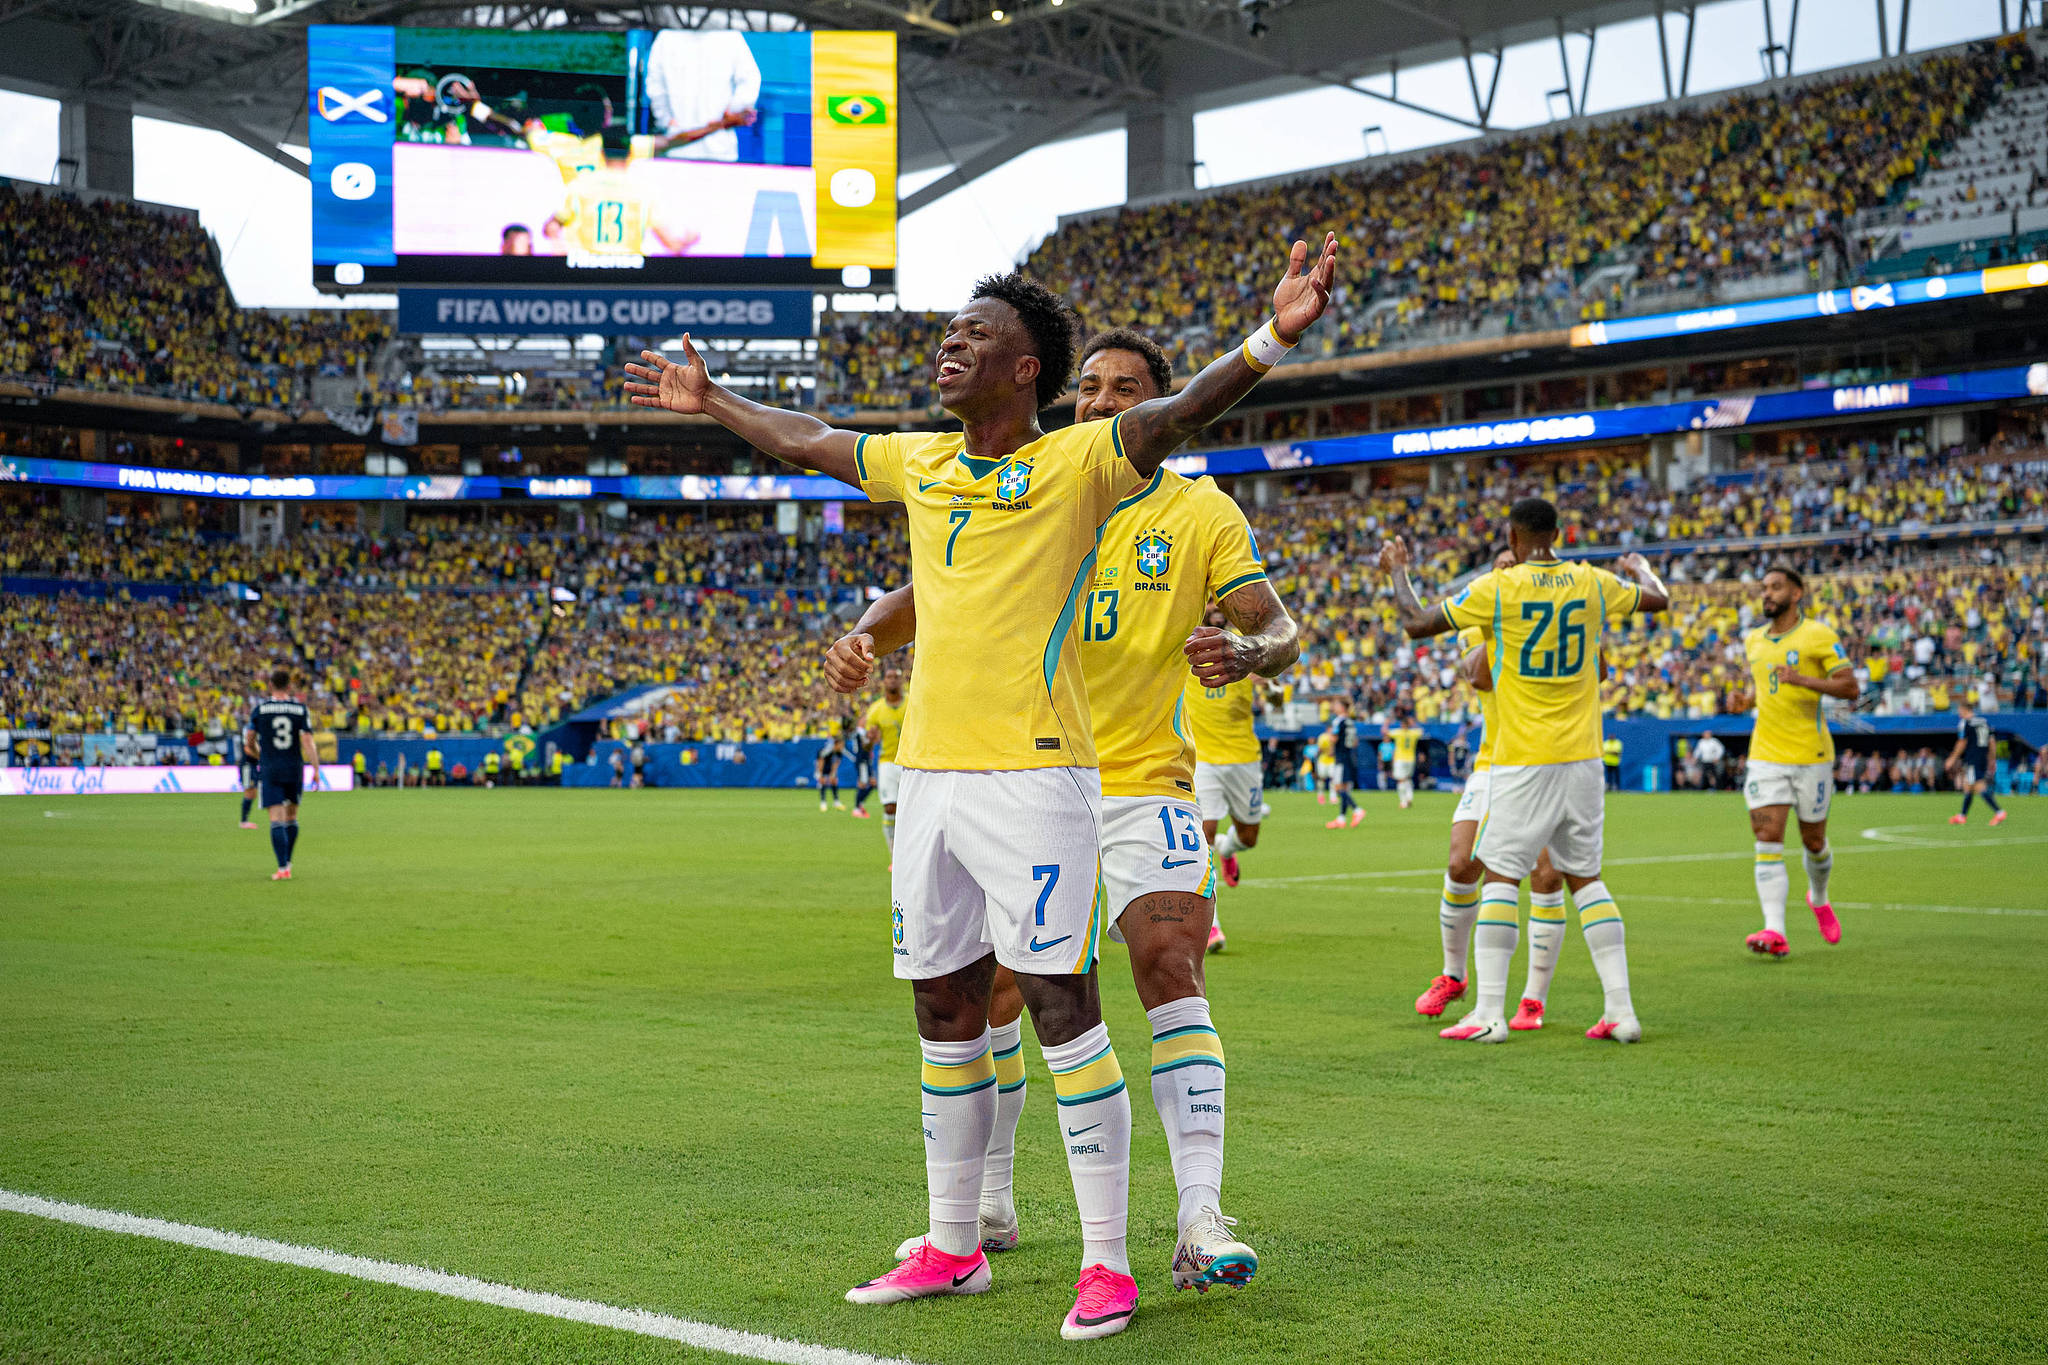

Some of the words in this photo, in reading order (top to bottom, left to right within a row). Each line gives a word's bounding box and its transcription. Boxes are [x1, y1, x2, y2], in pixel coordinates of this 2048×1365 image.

[597, 200, 623, 243] 13
[437, 299, 500, 323] FIFA
[502, 300, 608, 324] WORLD
[611, 301, 670, 325] CUP
[672, 301, 775, 325] 2026
[1430, 425, 1493, 450] WORLD
[1493, 421, 1530, 445] CUP
[118, 468, 156, 488] FIFA
[156, 471, 216, 493] WORLD
[216, 476, 249, 495] CUP
[991, 501, 1033, 511] BRASIL
[945, 510, 972, 567] 7
[1134, 582, 1171, 591] BRASIL
[1083, 590, 1119, 641] 13
[1519, 599, 1587, 678] 26
[1768, 669, 1779, 695] 9
[271, 715, 293, 750] 3
[1158, 806, 1200, 851] 13
[1032, 864, 1060, 926] 7
[1070, 1144, 1104, 1155] BRASIL
